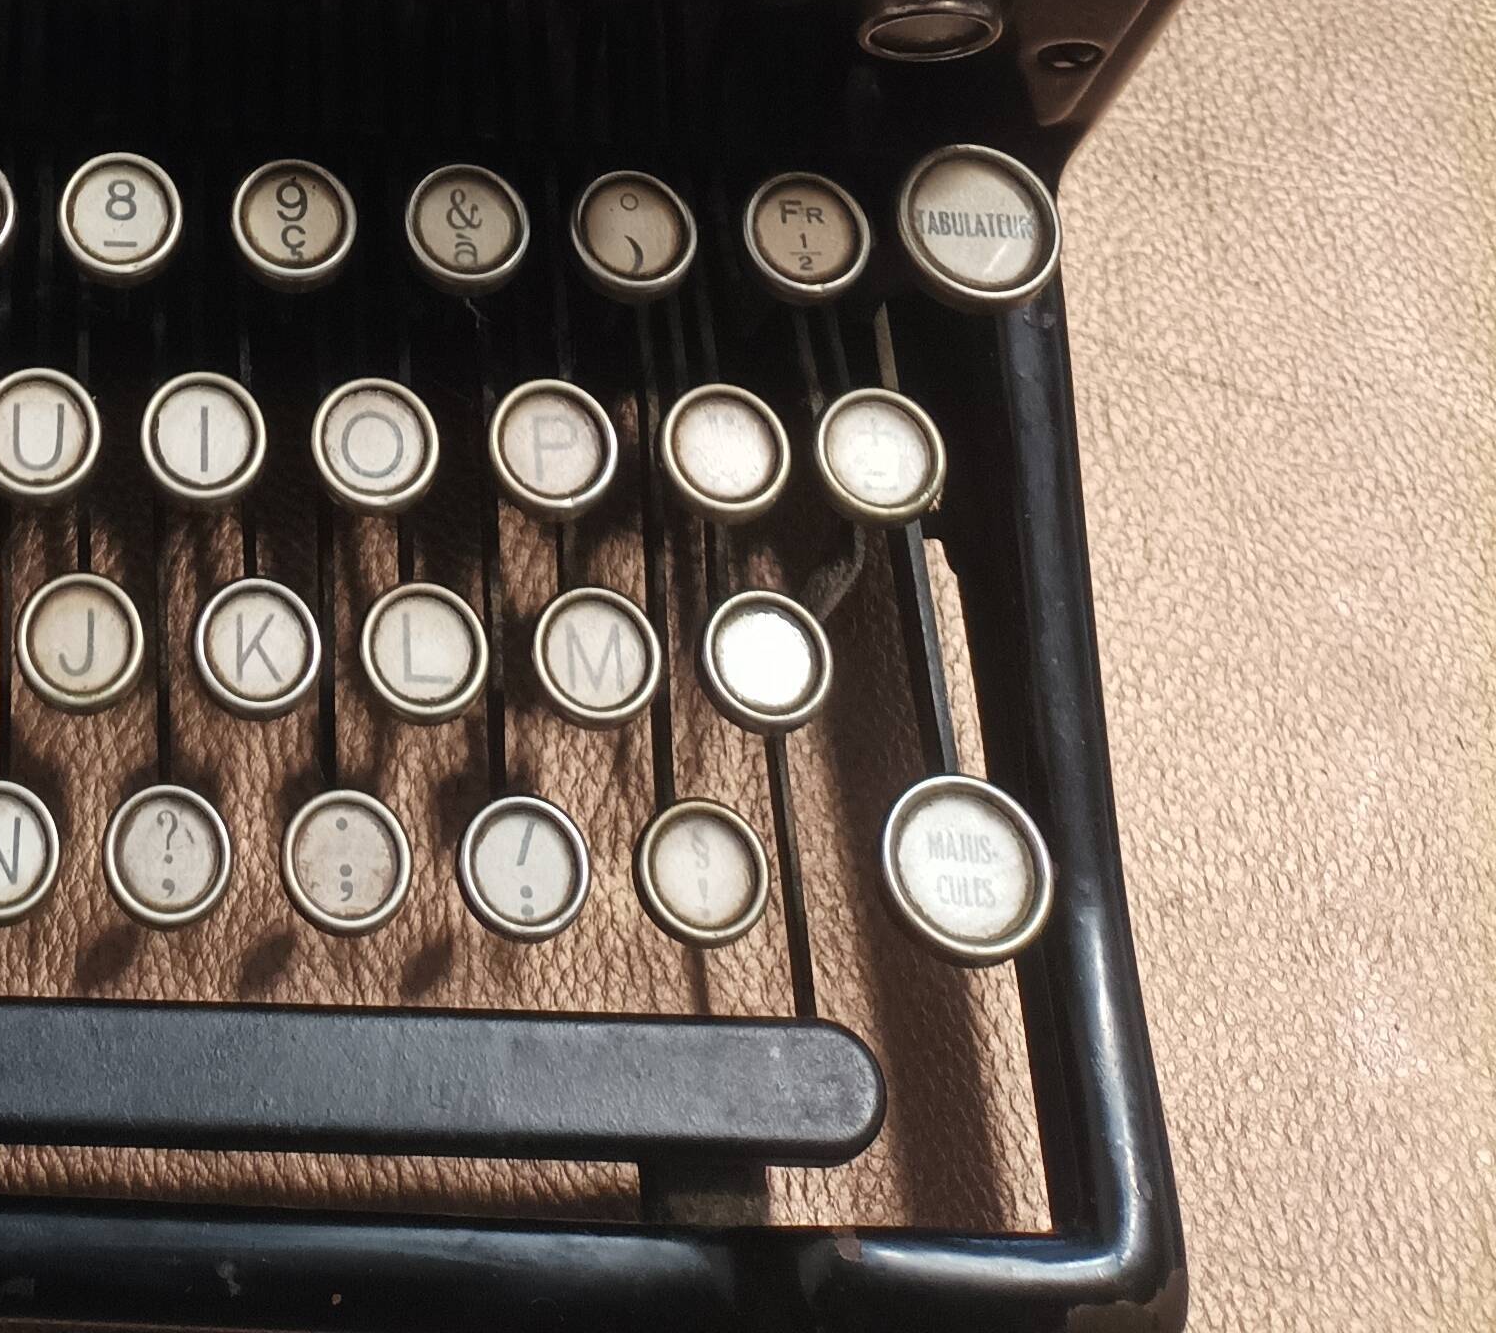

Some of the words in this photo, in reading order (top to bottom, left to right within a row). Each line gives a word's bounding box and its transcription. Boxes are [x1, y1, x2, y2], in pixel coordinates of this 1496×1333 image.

[104, 179, 138, 221] 8
[275, 179, 309, 222] 9
[446, 188, 483, 229] &
[12, 402, 65, 471] U
[199, 405, 209, 473] I
[340, 410, 404, 479] O
[531, 413, 580, 482] P
[58, 607, 96, 677] J
[235, 612, 283, 684] K
[401, 611, 453, 684] L
[565, 619, 625, 692] M
[156, 809, 179, 865] ?
